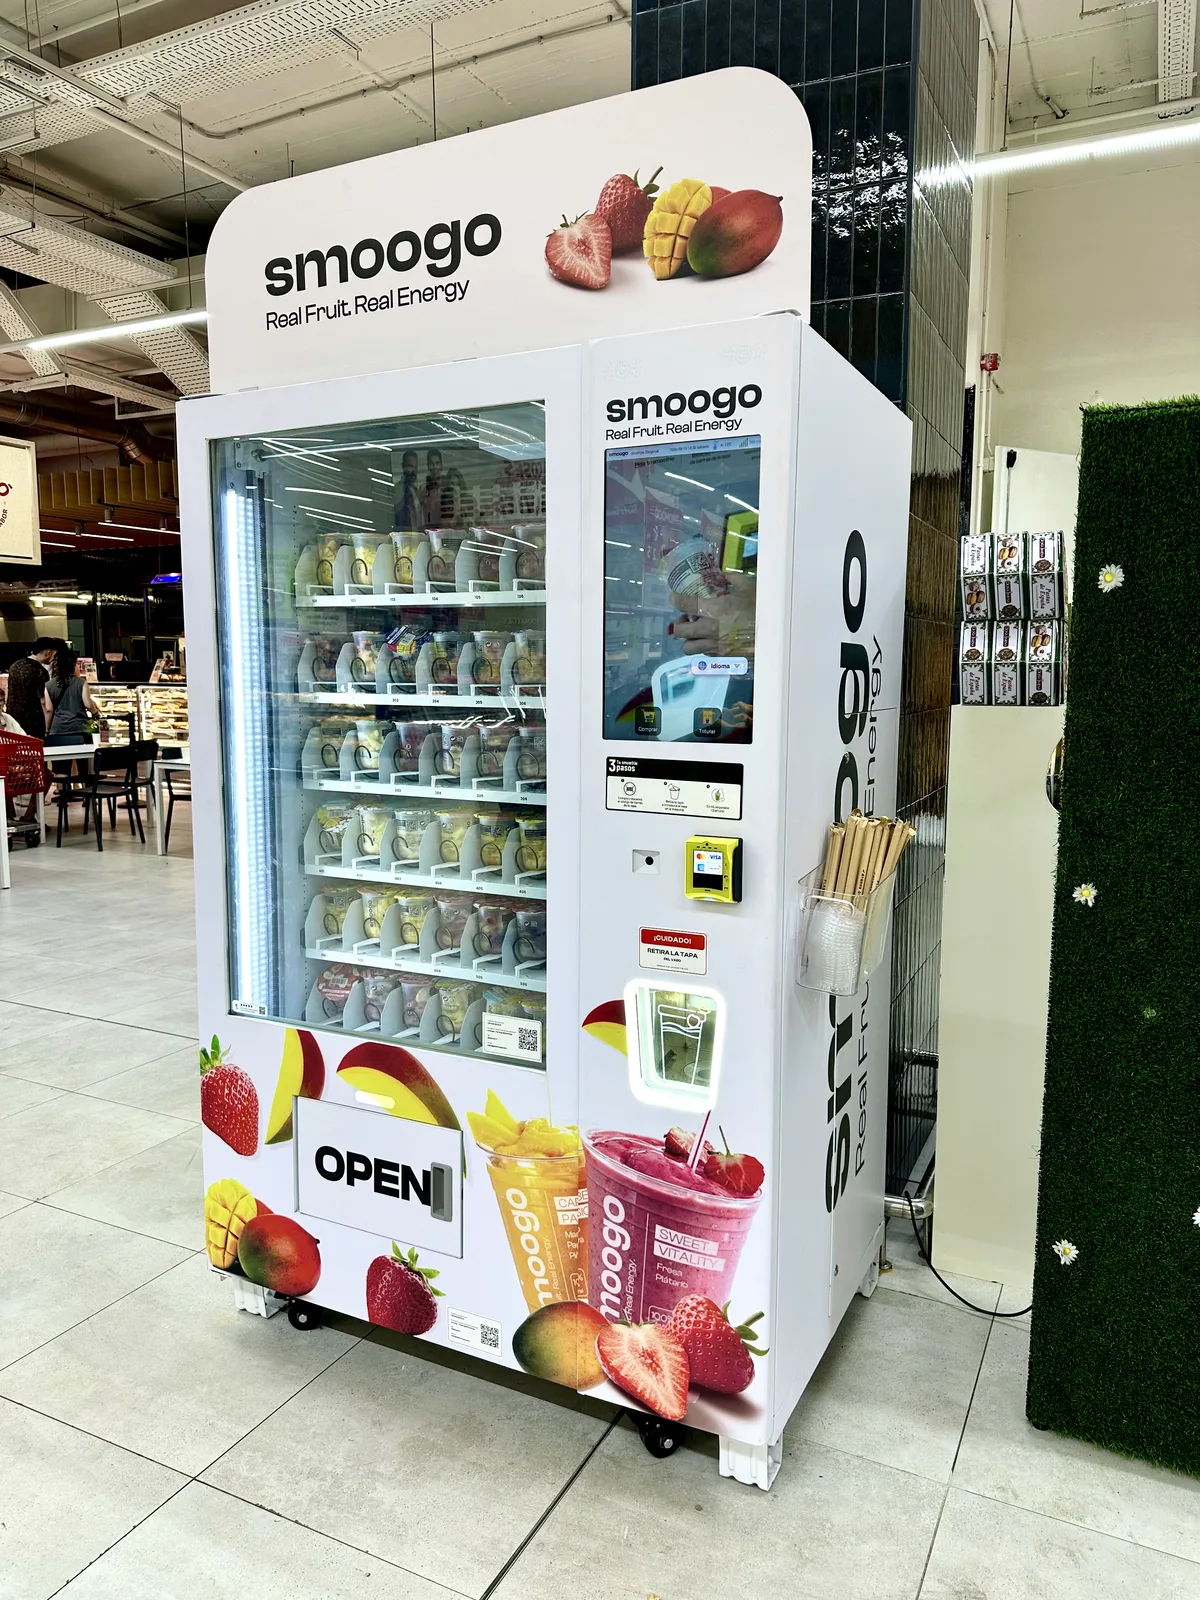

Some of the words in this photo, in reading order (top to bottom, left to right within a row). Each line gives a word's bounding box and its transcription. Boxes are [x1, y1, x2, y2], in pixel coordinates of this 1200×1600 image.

[264, 213, 502, 296] smoogo
[266, 305, 303, 330] Real
[305, 296, 352, 324] Fruit.
[355, 290, 393, 314] Real
[397, 280, 470, 309] Energy
[606, 384, 762, 422] smoogo
[605, 427, 631, 441] Real
[666, 421, 692, 434] Real
[694, 418, 743, 432] Energy
[608, 758, 616, 772] 3
[824, 530, 870, 1213] smogo
[855, 1070, 868, 1177] Real
[864, 634, 882, 816] Energy
[654, 935, 692, 944] ¡CUIDADO!
[315, 1146, 431, 1206] OPEN
[506, 1188, 552, 1307] moogo
[600, 1194, 631, 1322] moogo
[659, 1245, 718, 1268] VITALITY
[660, 1228, 710, 1251] SWEET
[656, 1262, 682, 1277] Fresa
[656, 1273, 688, 1288] Plátano
